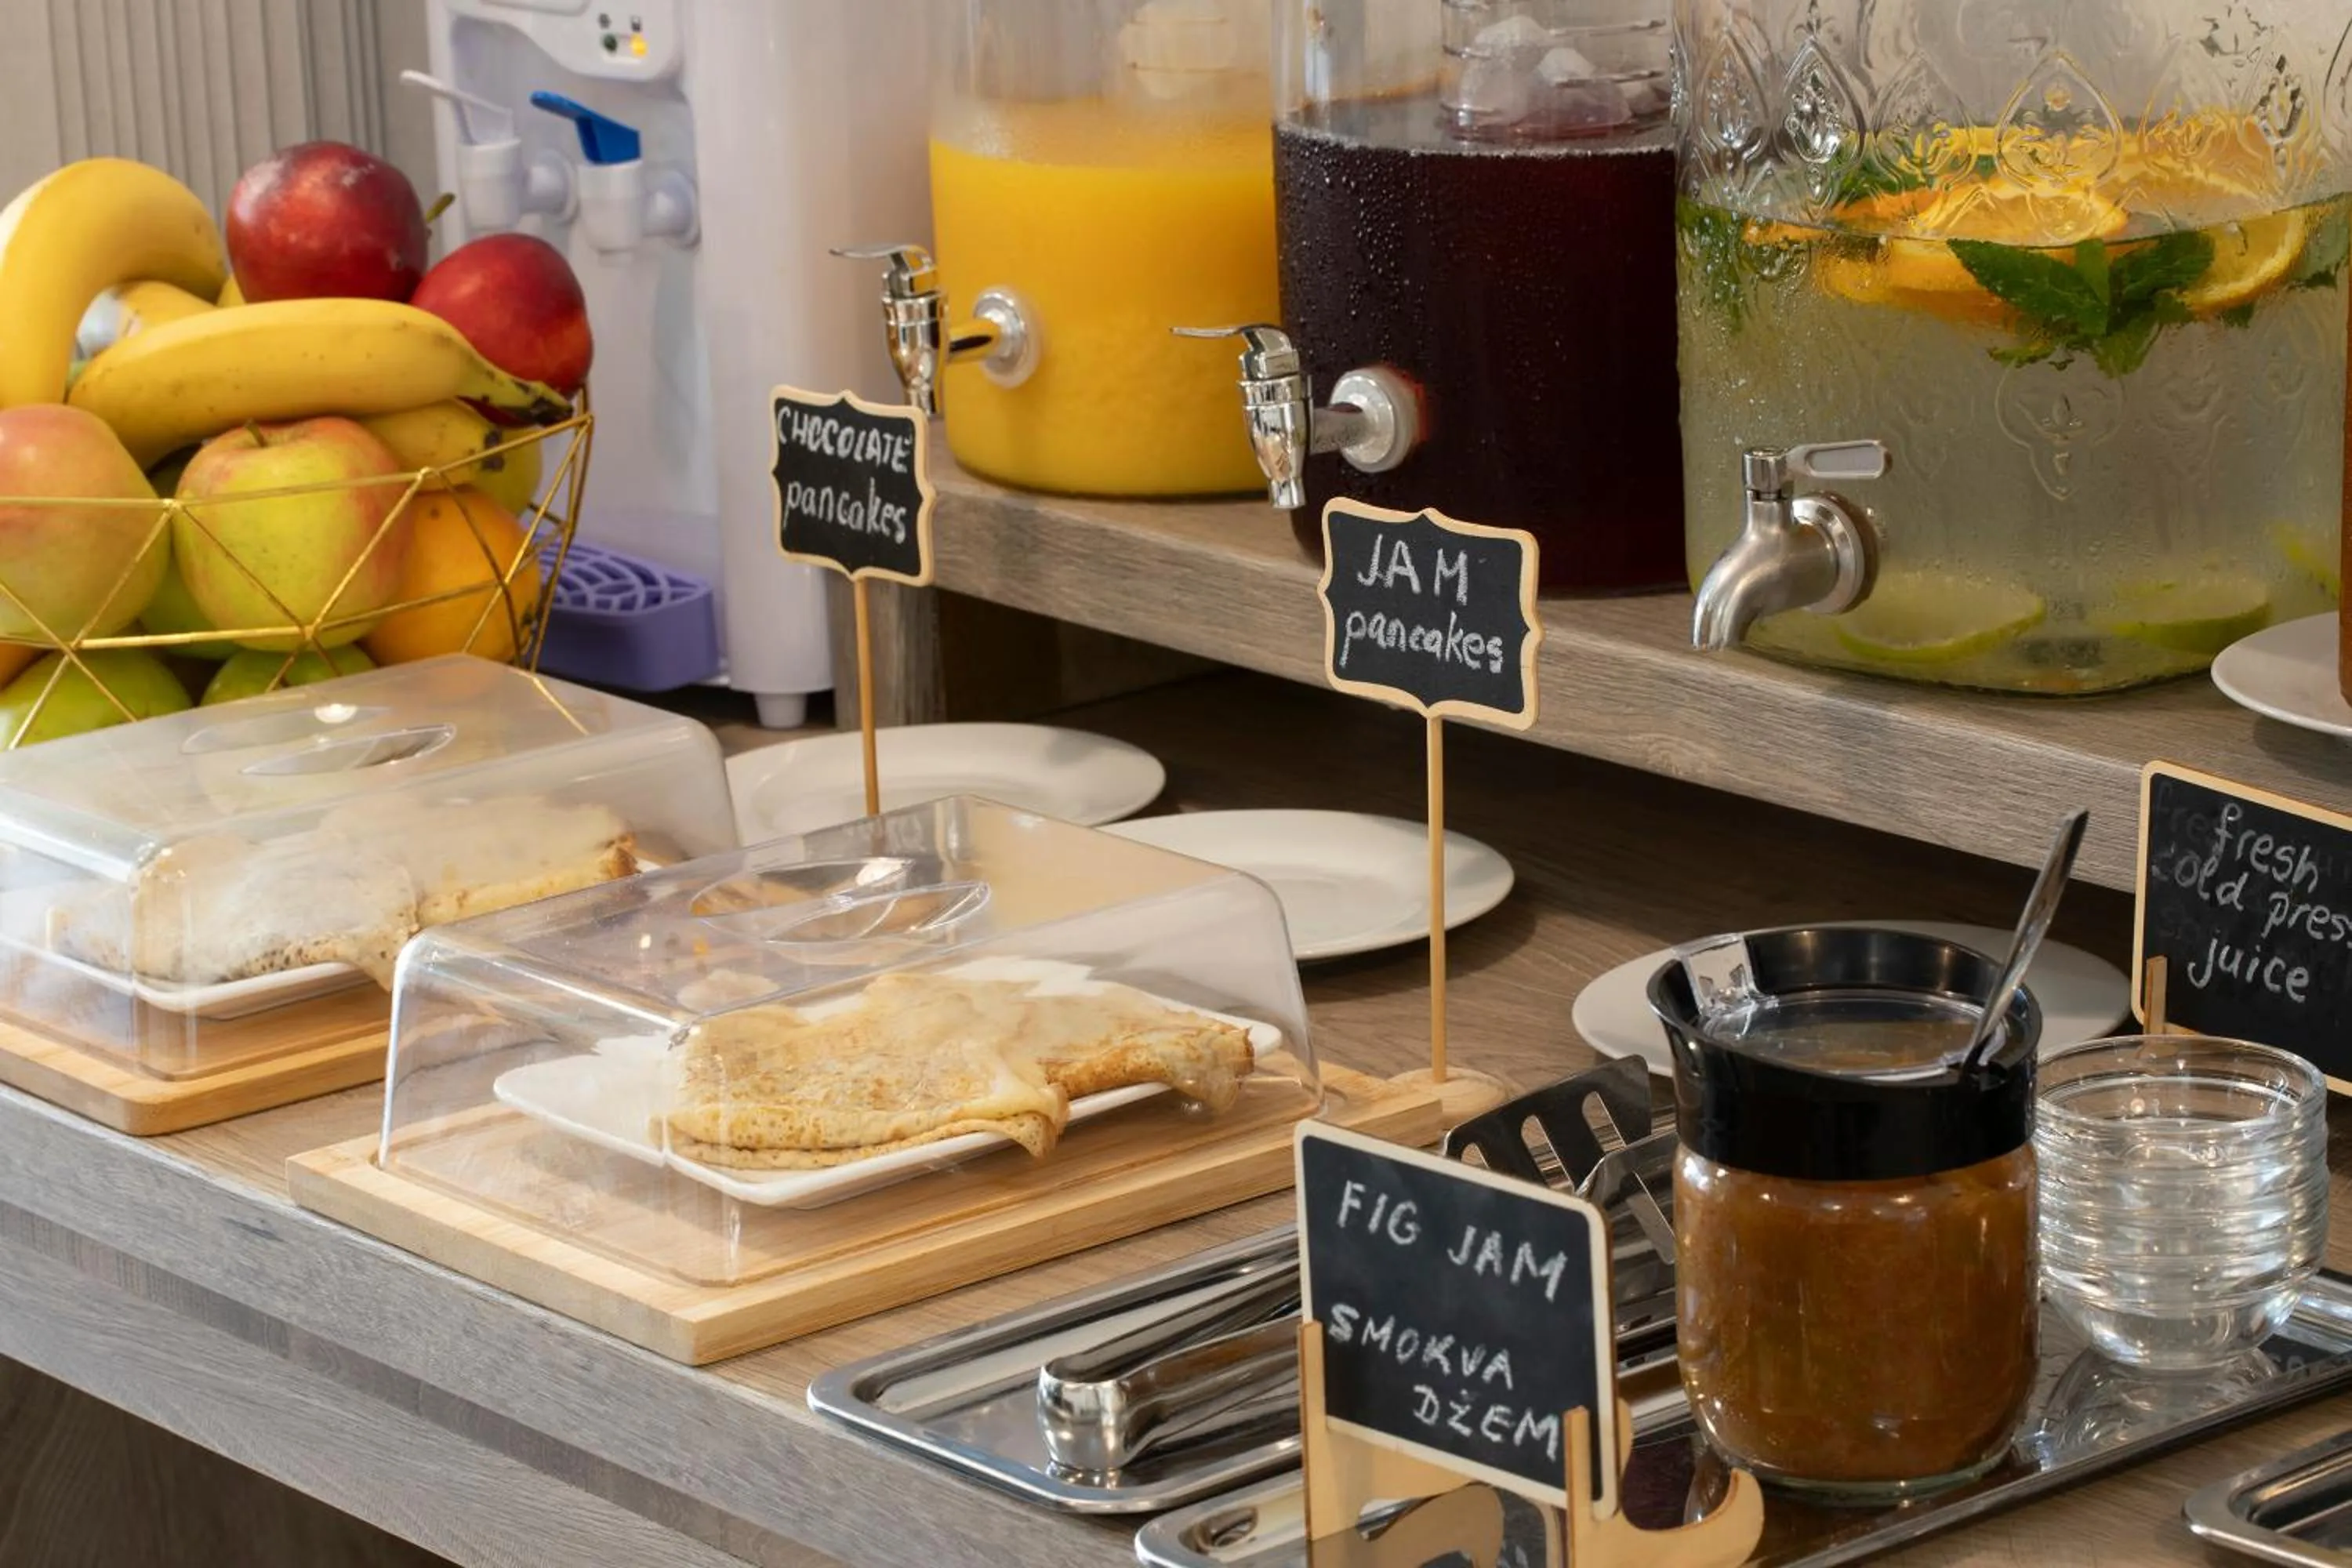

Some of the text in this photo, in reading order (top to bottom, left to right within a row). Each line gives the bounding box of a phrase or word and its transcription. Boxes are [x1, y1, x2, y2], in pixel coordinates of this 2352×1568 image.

[777, 405, 912, 473] CHOCOLATE
[782, 477, 906, 544] pancakes
[1357, 533, 1468, 606] JAM
[1338, 611, 1504, 674] pancakes
[2212, 802, 2319, 894] fresh
[2187, 928, 2310, 1004] juice
[1336, 1180, 1568, 1303] FIG JAM
[1328, 1302, 1514, 1391] SMOKVA
[1413, 1383, 1560, 1463] DŽEM
